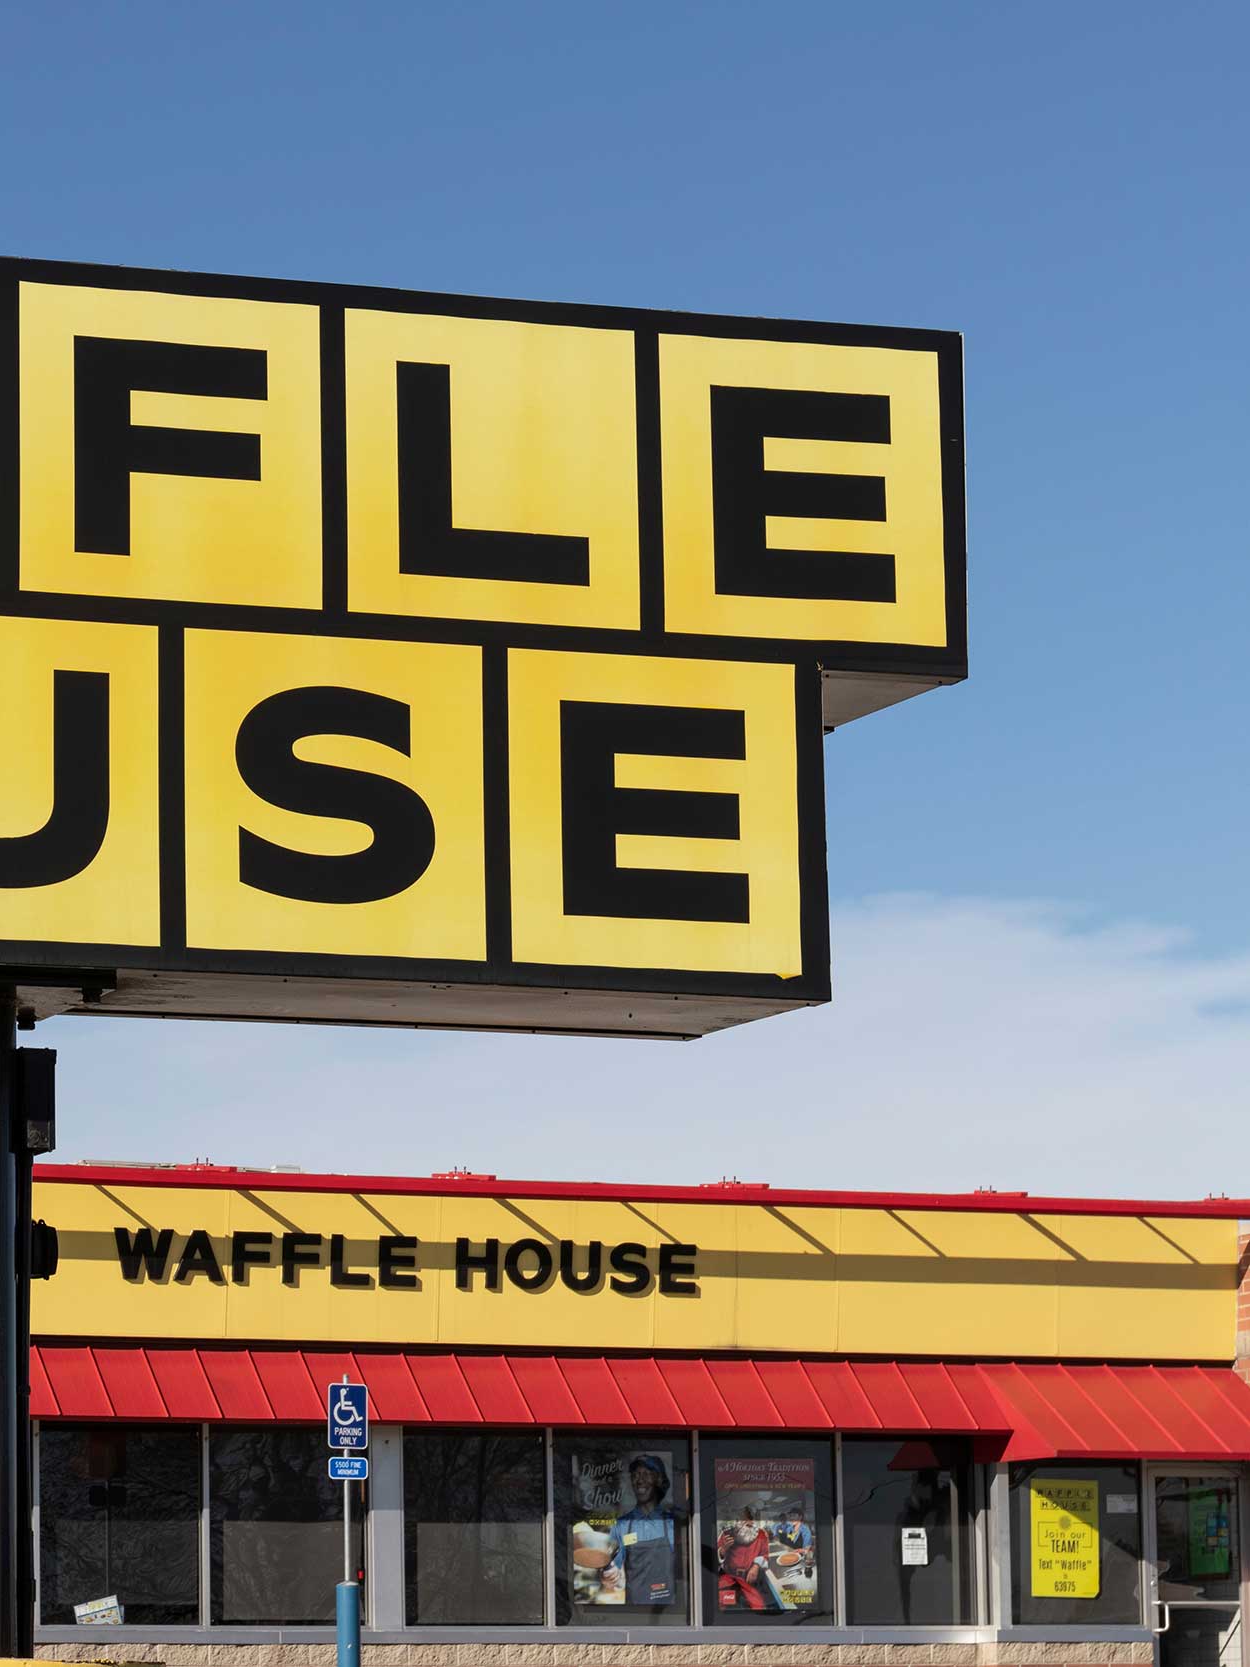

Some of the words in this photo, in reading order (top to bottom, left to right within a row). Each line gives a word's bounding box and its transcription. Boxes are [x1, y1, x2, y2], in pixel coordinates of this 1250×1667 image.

[114, 1227, 419, 1287] WAFFLE
[455, 1237, 697, 1294] HOUSE
[334, 1427, 362, 1436] PARKING
[339, 1436, 358, 1446] ONLY
[335, 1461, 349, 1469] $500
[350, 1461, 362, 1469] FINE
[581, 1459, 623, 1478] Dinner
[1044, 1530, 1066, 1538] Join
[1051, 1540, 1079, 1554] TEAM!
[1038, 1559, 1052, 1570] Text
